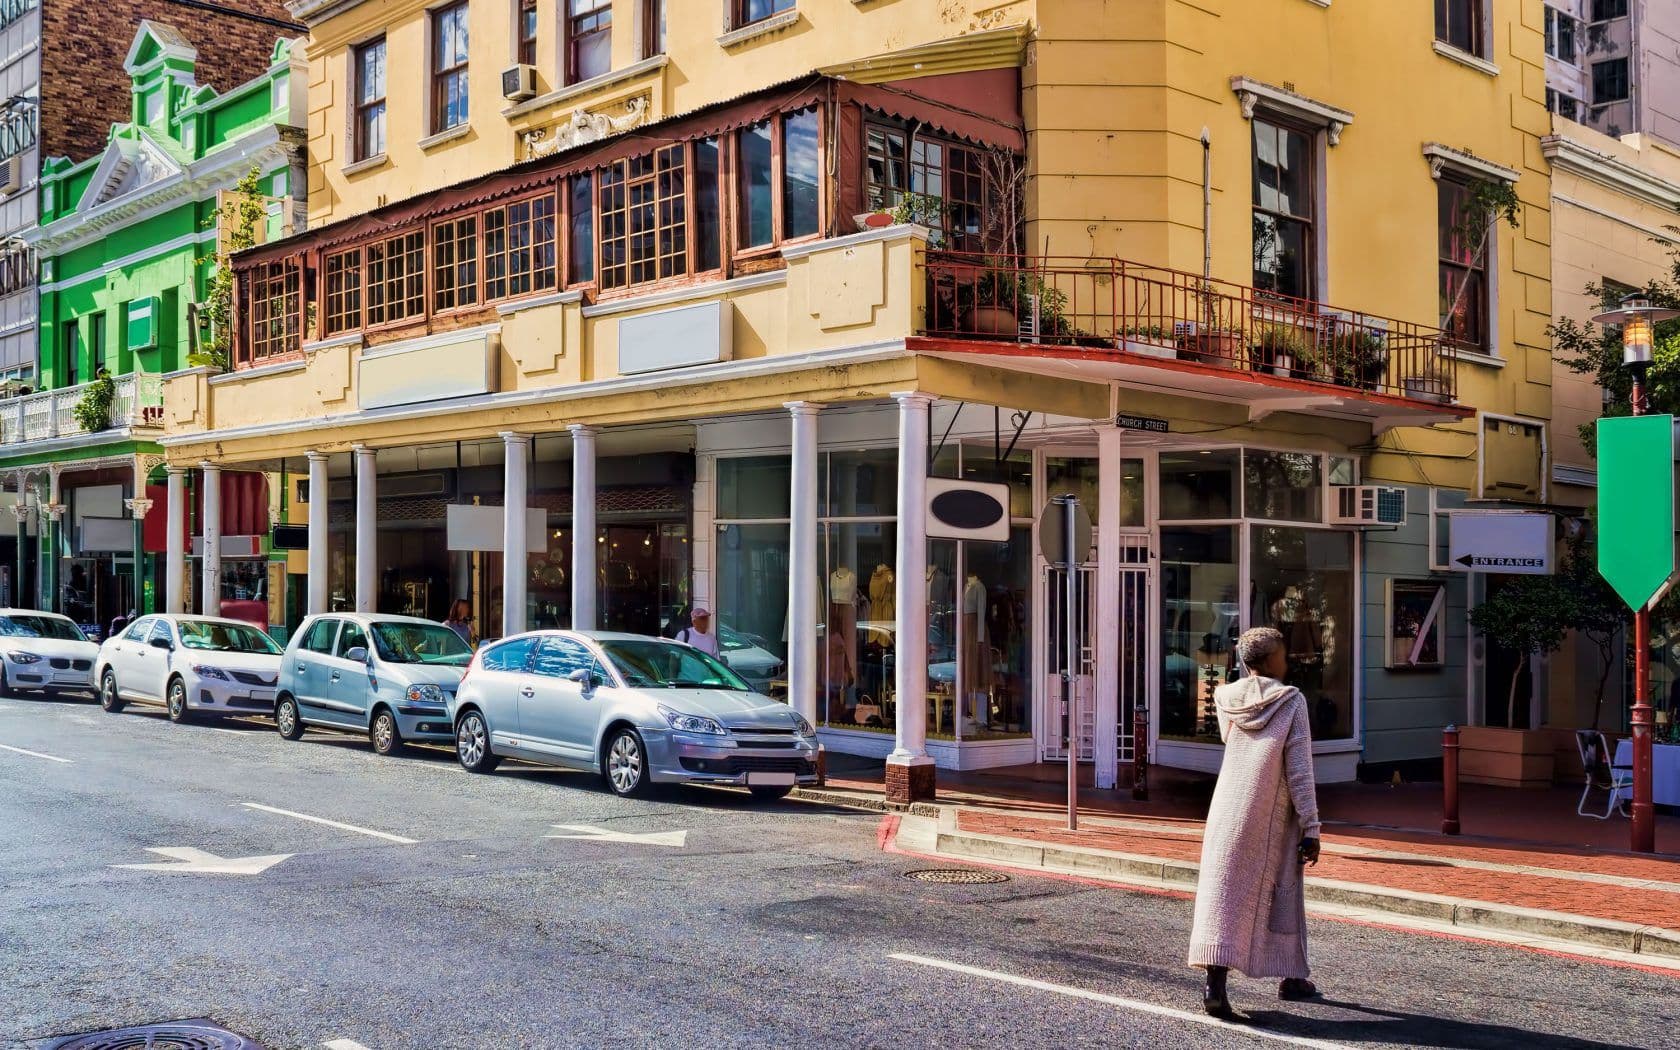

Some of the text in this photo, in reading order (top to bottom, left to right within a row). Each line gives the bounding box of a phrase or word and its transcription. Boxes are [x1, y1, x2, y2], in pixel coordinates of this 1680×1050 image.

[1117, 416, 1167, 431] CHURCH STREET
[1473, 557, 1541, 566] ENTRANCE
